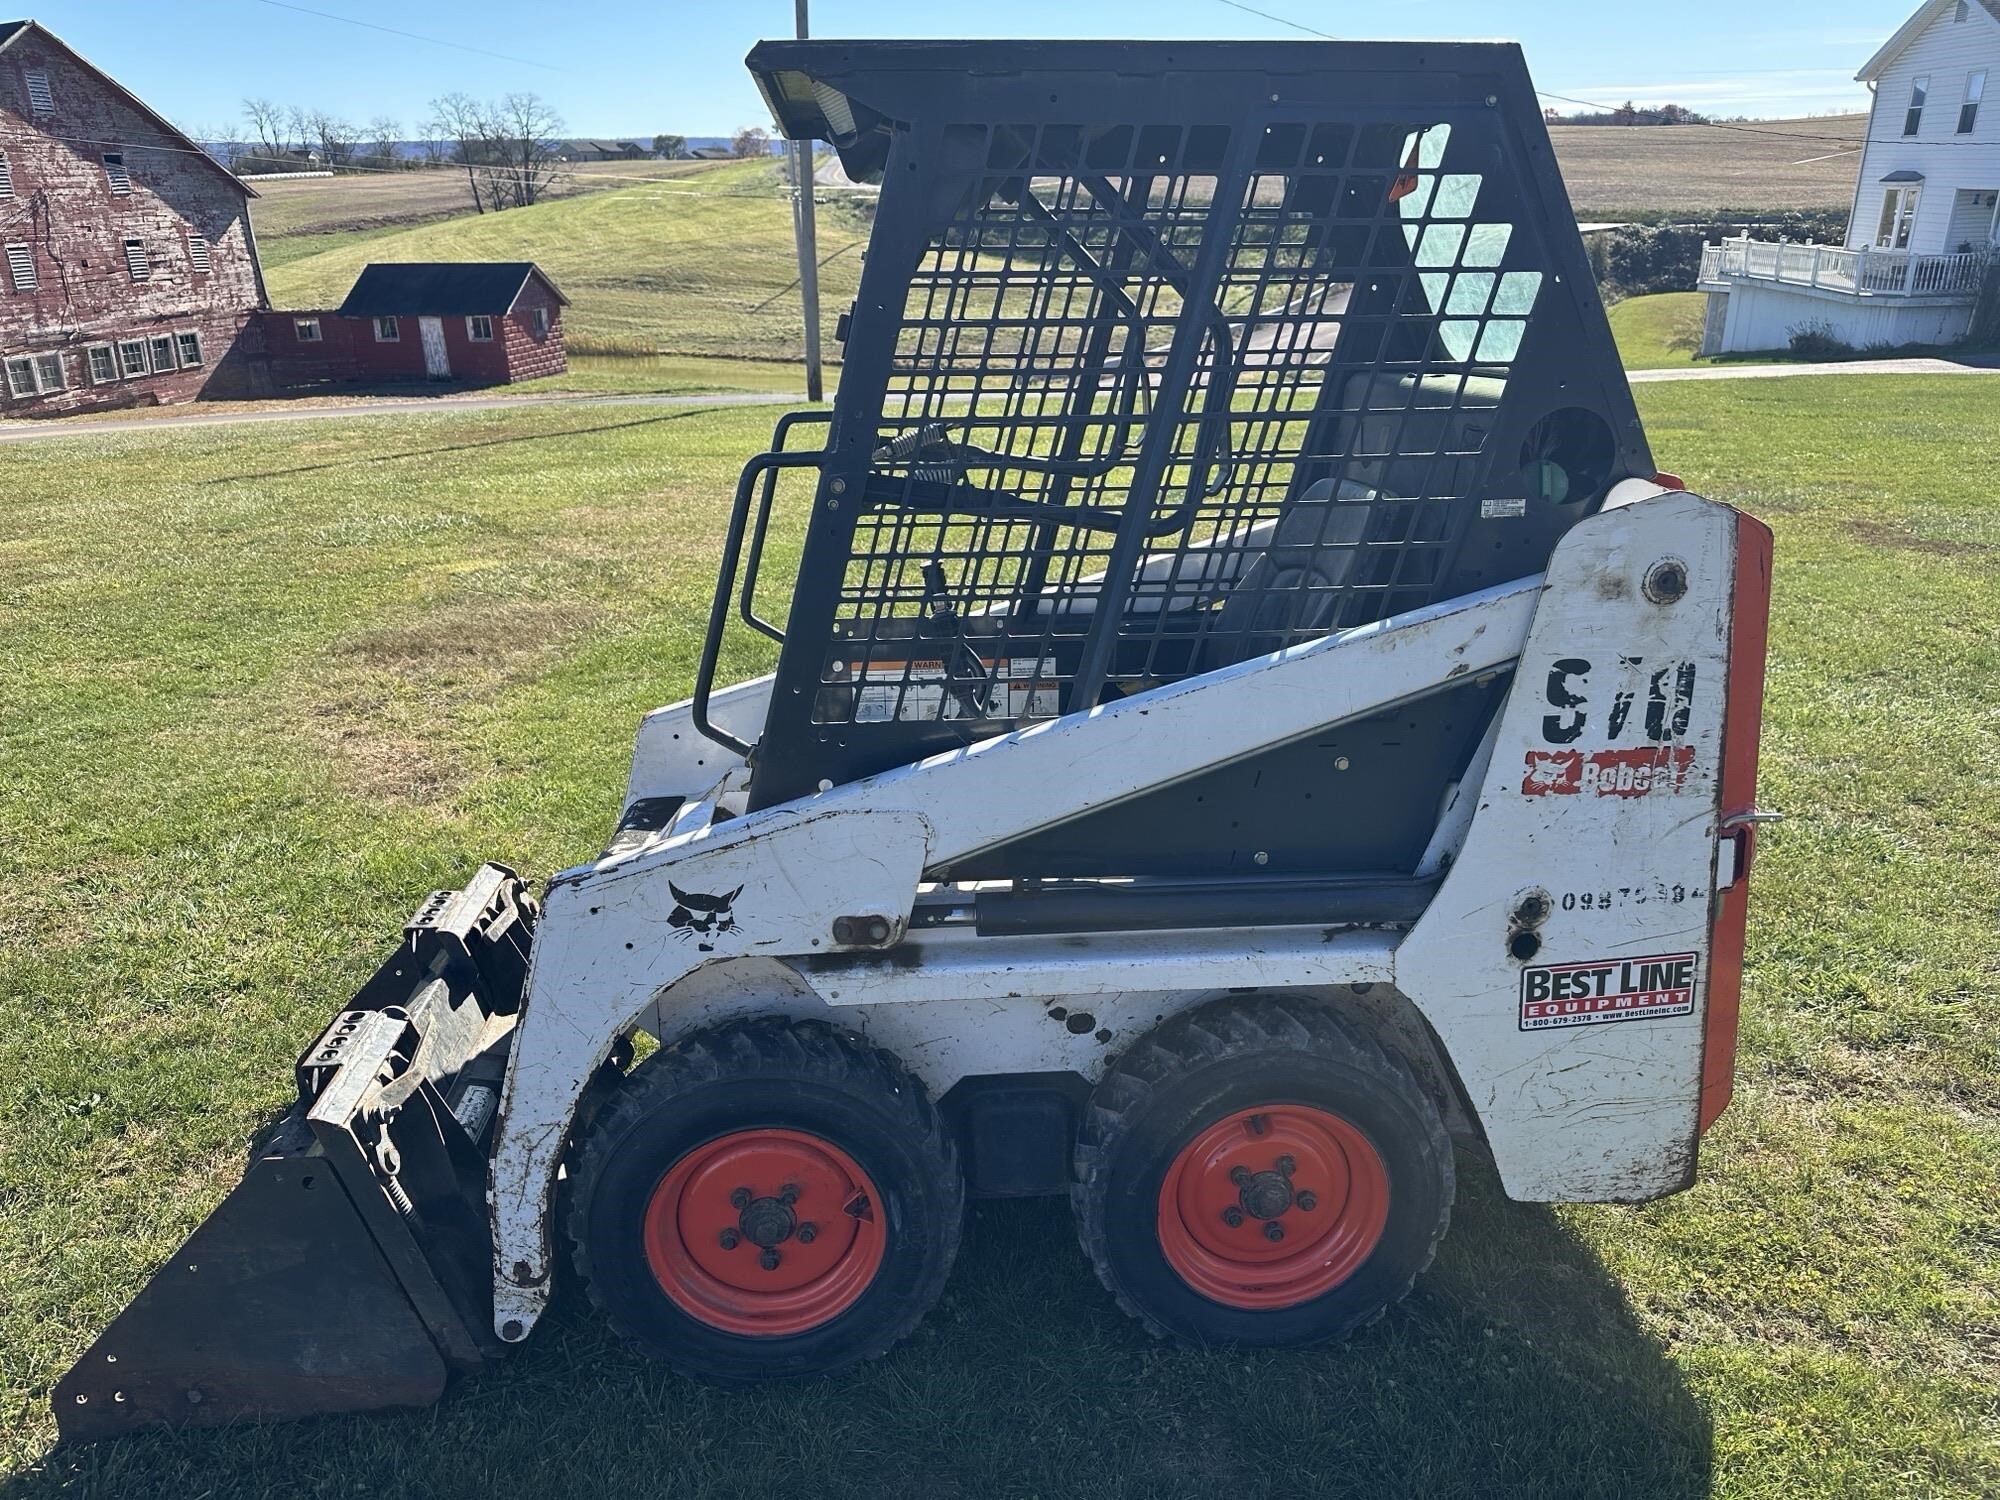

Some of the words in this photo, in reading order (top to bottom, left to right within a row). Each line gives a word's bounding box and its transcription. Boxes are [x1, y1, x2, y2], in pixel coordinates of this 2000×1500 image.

[1525, 968, 1613, 1003] BEST
[1620, 961, 1695, 995] LINE
[1527, 991, 1688, 1016] EQUIPMENT
